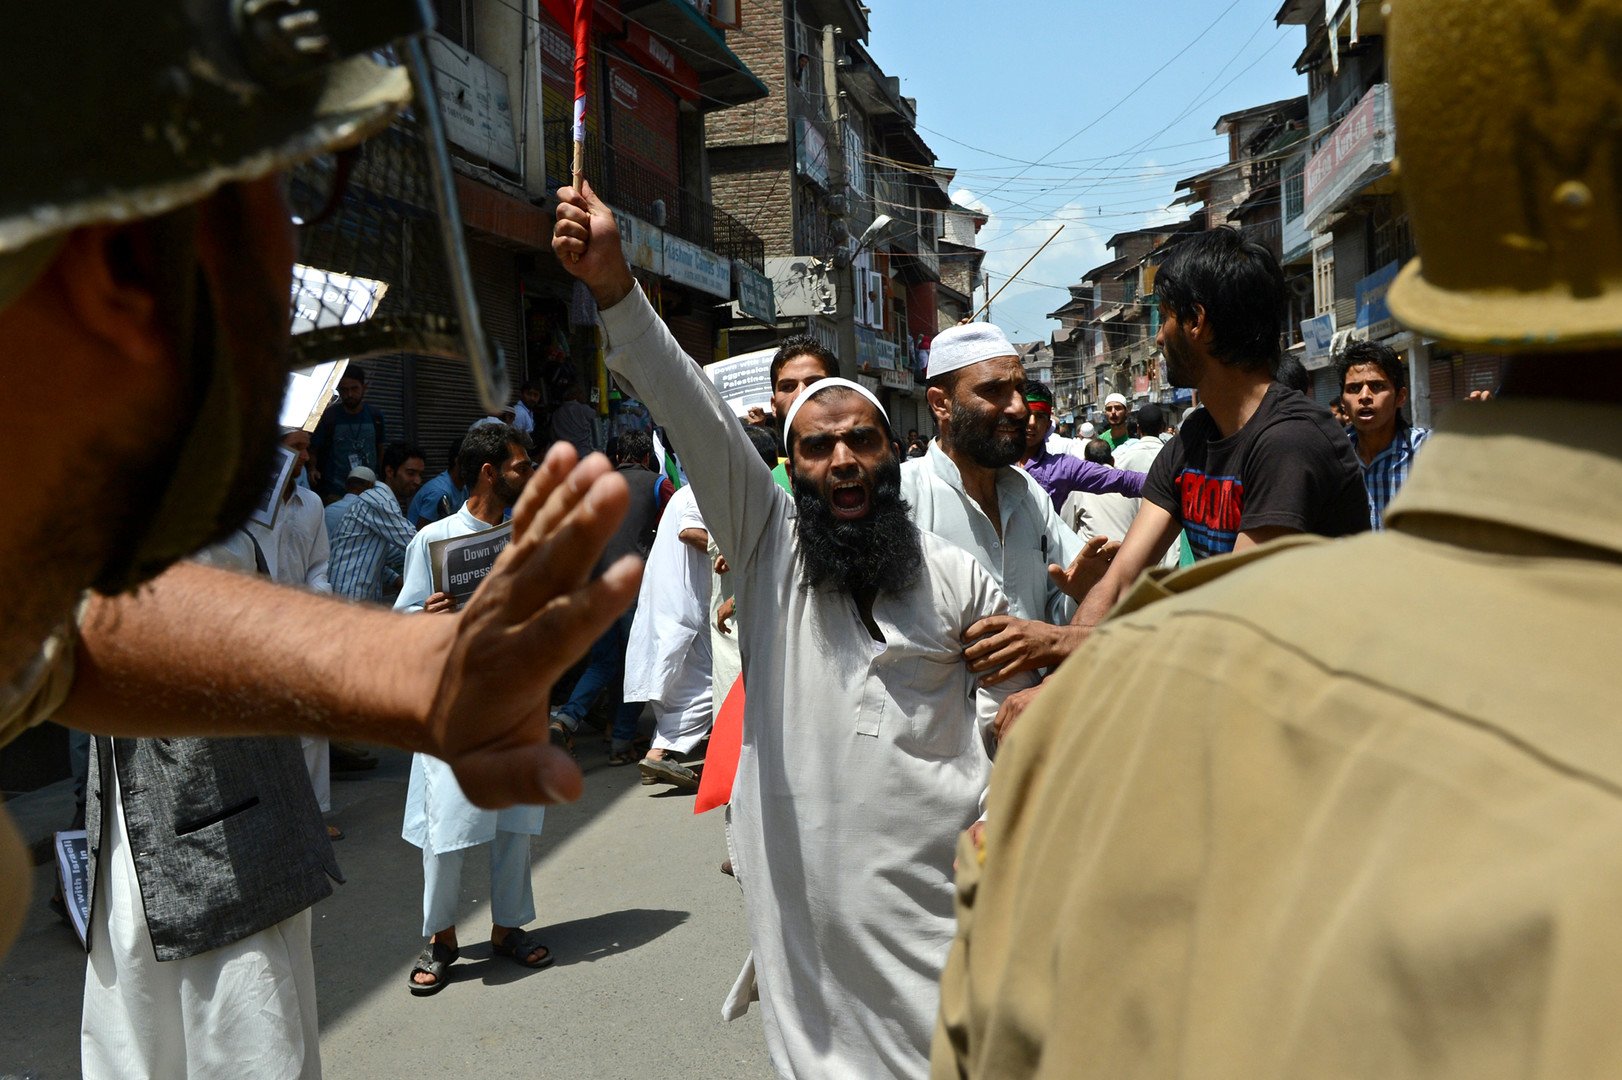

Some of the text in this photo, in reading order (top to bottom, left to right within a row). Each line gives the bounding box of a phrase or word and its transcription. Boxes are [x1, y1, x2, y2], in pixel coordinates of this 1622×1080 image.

[714, 363, 737, 375] Down
[740, 359, 759, 368] with
[722, 366, 769, 381] aggression
[463, 547, 490, 562] Down
[450, 563, 494, 585] aggressi
[63, 840, 81, 874] Israeli
[74, 878, 85, 904] with
